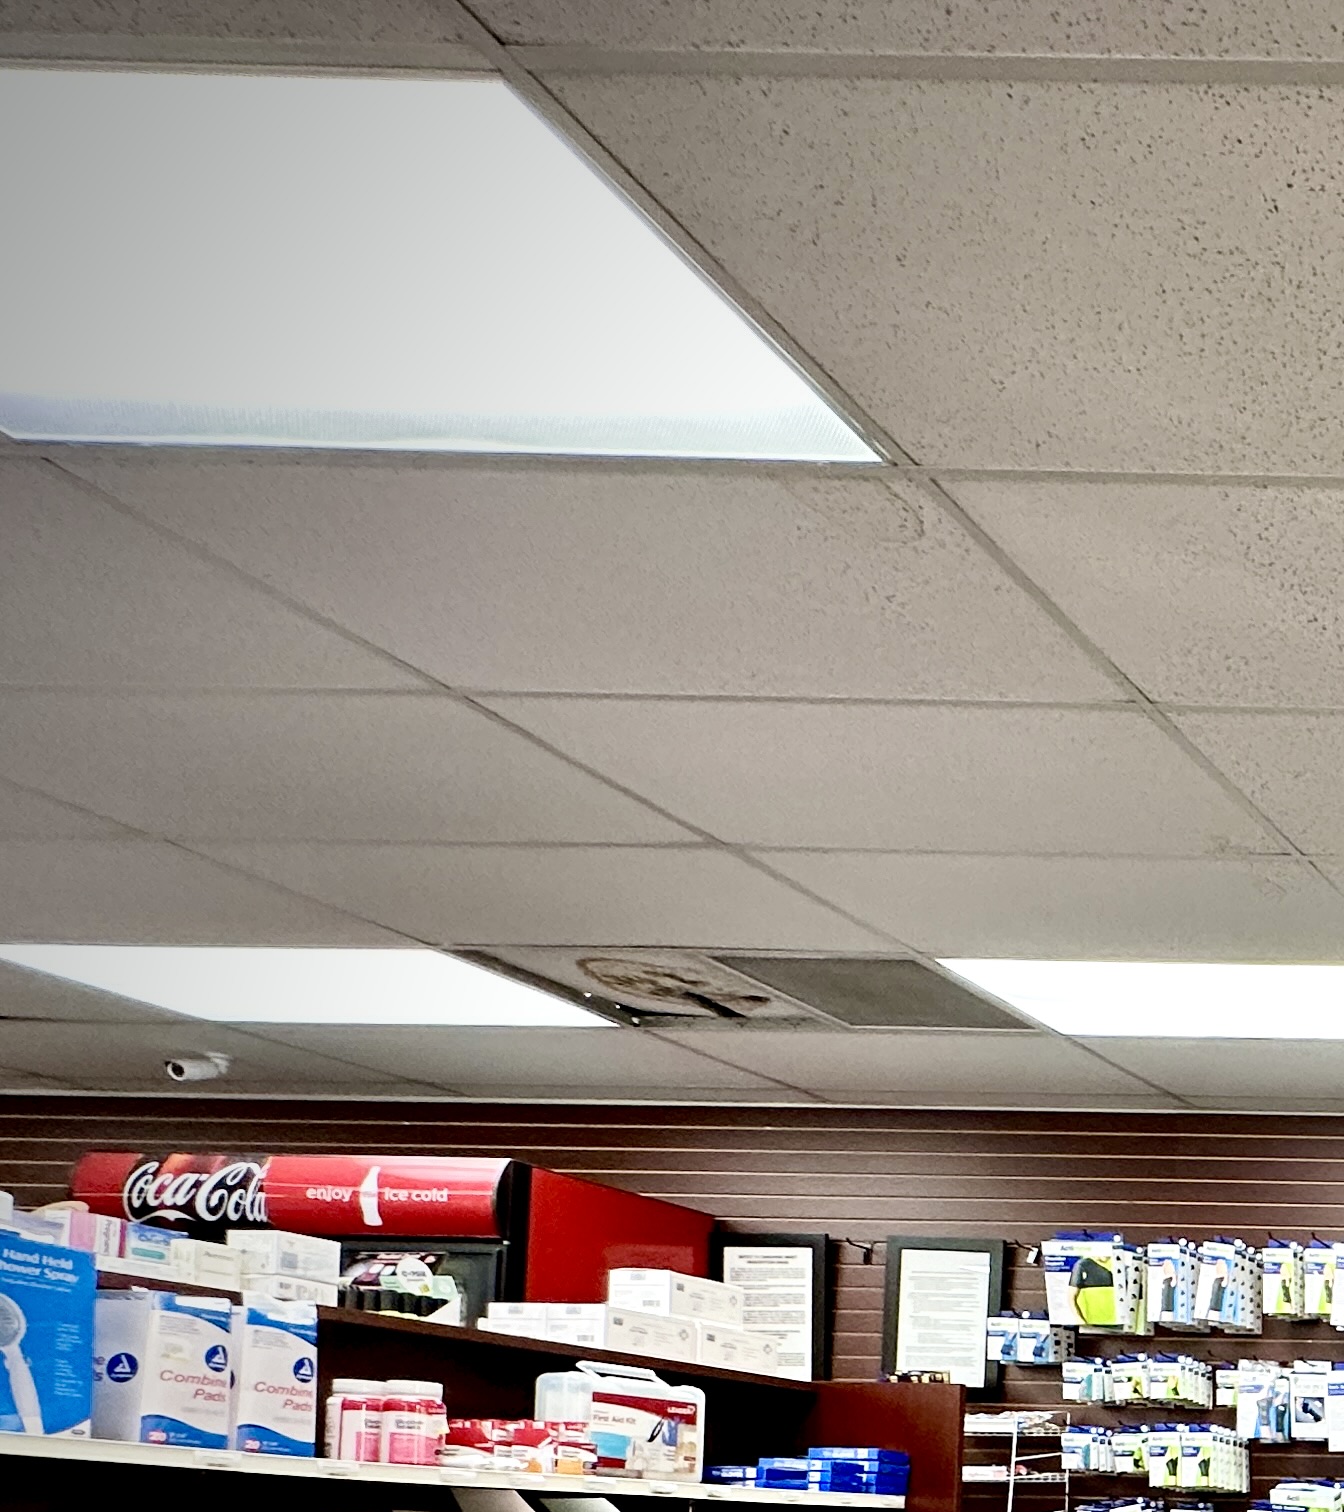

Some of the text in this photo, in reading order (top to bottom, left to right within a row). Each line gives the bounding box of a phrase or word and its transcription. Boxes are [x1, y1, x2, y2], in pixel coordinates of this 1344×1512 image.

[122, 1161, 268, 1223] Coca-Cola
[306, 1187, 448, 1203] enjoy ice cold
[3, 1248, 74, 1271] Hand Held
[0, 1260, 80, 1285] hower Spray
[193, 1388, 227, 1403] Pads
[282, 1399, 313, 1412] Pads
